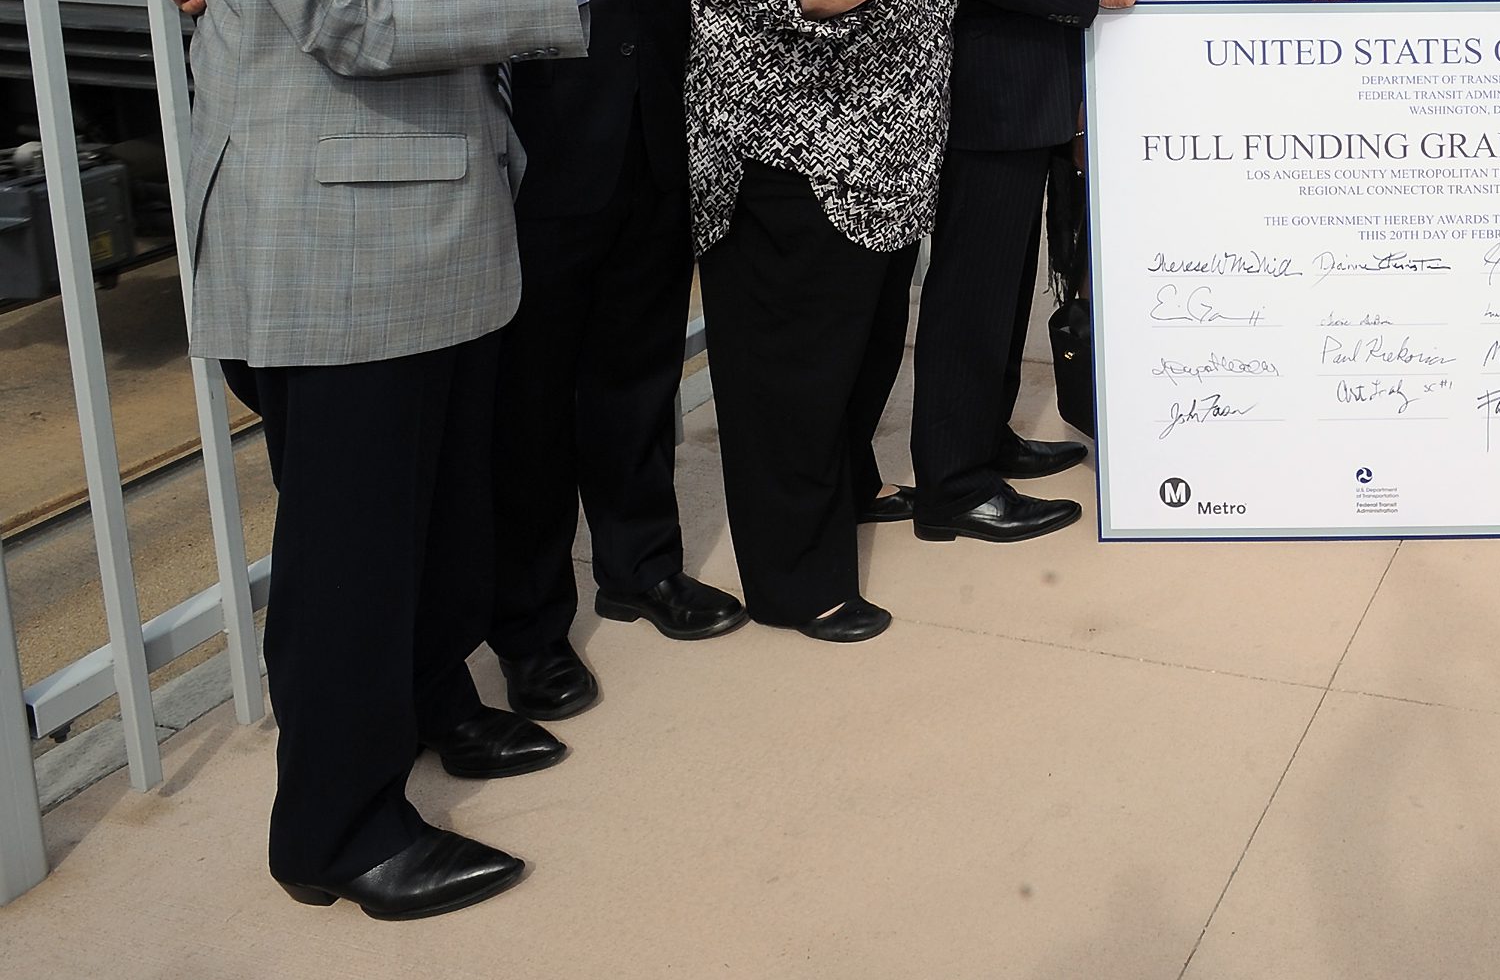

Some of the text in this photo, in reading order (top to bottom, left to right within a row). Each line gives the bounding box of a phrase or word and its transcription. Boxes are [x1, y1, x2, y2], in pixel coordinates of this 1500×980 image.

[1204, 39, 1343, 66] UNITED
[1354, 38, 1482, 66] STATES
[1361, 75, 1440, 86] DEPARTMENT
[1441, 74, 1458, 85] OF
[1358, 90, 1412, 101] FEDERAL
[1413, 90, 1464, 100] TRANSIT
[1409, 105, 1491, 117] WASHINGTON,
[1141, 134, 1234, 161] FULL
[1242, 133, 1410, 161] FUNDING
[1246, 169, 1271, 180] LOS
[1272, 169, 1331, 180] ANGELES
[1333, 168, 1388, 179] COUNTY
[1390, 167, 1490, 179] METROPOLITAN
[1298, 185, 1365, 196] REGIONAL
[1366, 184, 1445, 195] CONNECTOR
[1263, 216, 1289, 227] THE
[1291, 215, 1381, 227] GOVERNMENT
[1383, 214, 1434, 226] HEREBY
[1437, 214, 1490, 225] AWARDS
[1357, 230, 1387, 241] THIS
[1389, 230, 1421, 241] 20TH
[1422, 229, 1449, 240] DAY
[1451, 229, 1468, 240] OF
[1197, 501, 1248, 515] Metro
